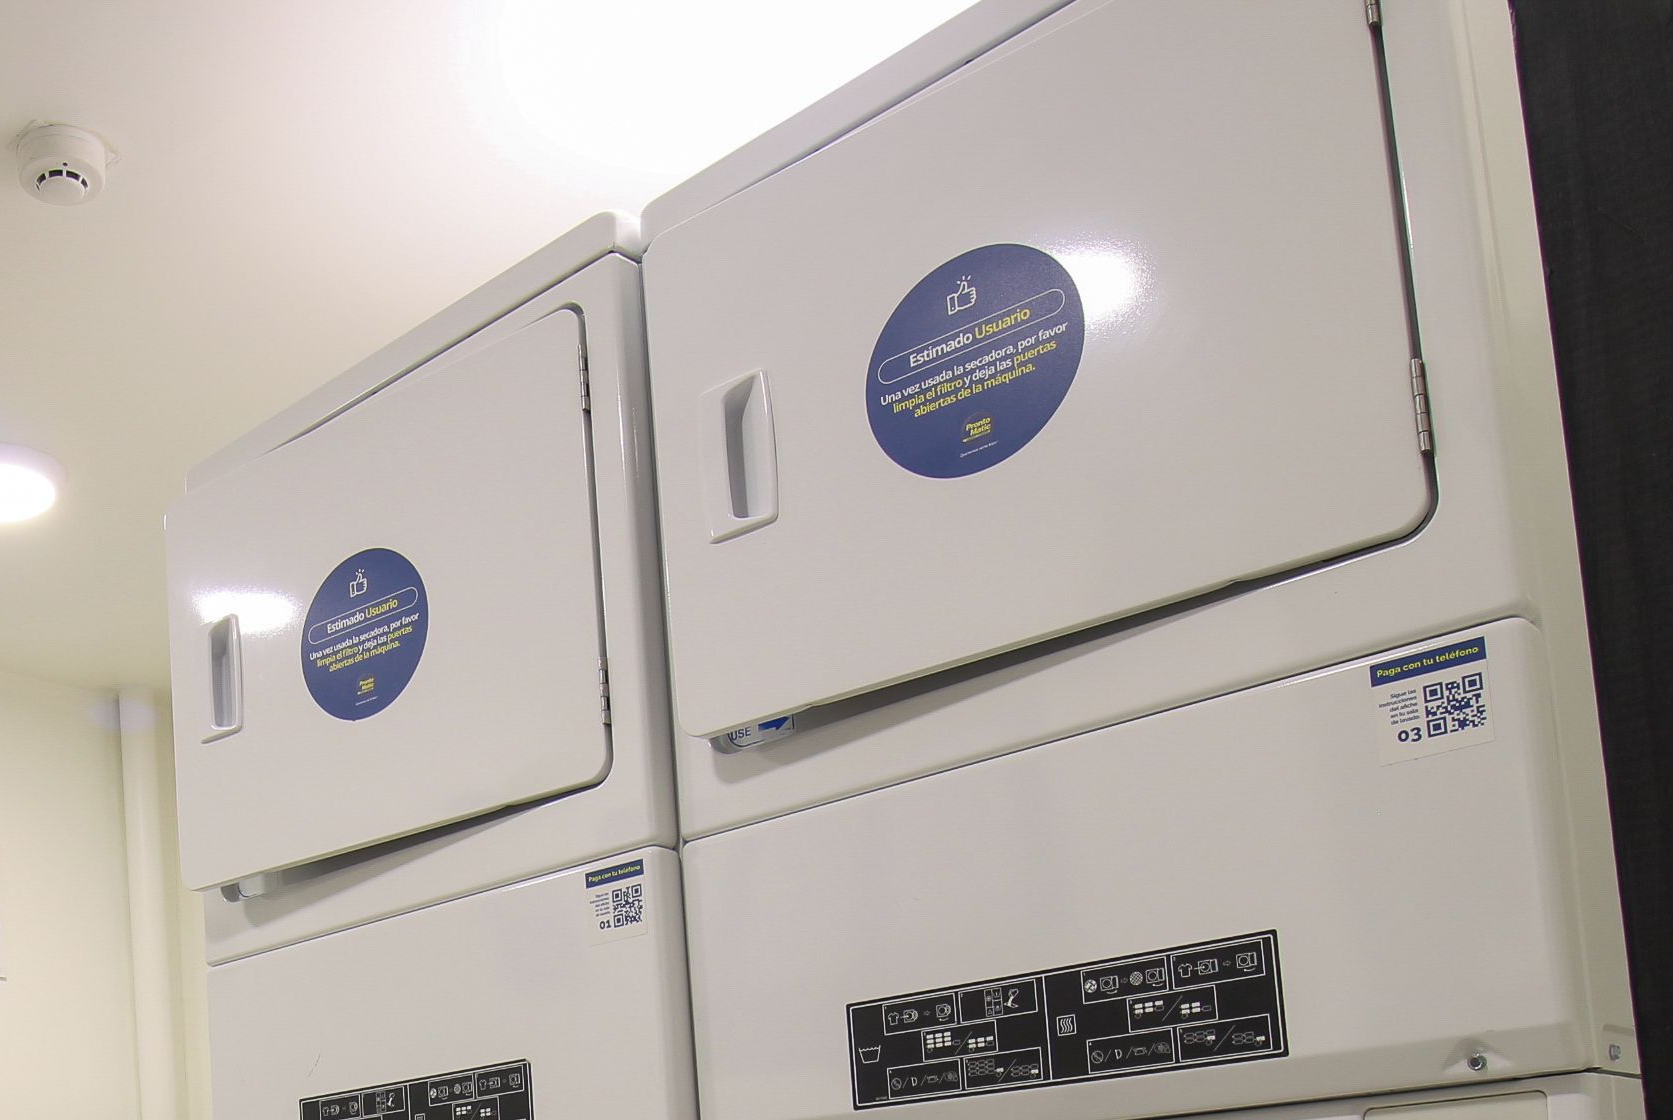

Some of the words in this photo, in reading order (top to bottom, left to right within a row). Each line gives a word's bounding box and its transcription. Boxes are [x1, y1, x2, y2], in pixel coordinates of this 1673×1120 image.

[909, 331, 973, 368] Estimado
[974, 307, 1032, 339] Usuario
[880, 389, 901, 406] Una
[902, 384, 920, 399] vez
[921, 370, 953, 390] usada
[953, 364, 964, 377] la
[965, 344, 1017, 374] secadora,
[1017, 336, 1037, 354] por
[1038, 322, 1068, 343] favor
[893, 394, 925, 414] limpia
[926, 388, 936, 400] el
[936, 377, 963, 397] filtro
[963, 374, 972, 388] y
[972, 365, 995, 386] deja
[996, 358, 1012, 372] las
[1013, 339, 1057, 368] puertas
[914, 394, 957, 418] abiertas
[957, 386, 971, 401] de
[972, 383, 982, 396] la
[984, 363, 1036, 392] máquina.
[966, 416, 991, 431] Pronto
[970, 424, 991, 436] Matic
[327, 610, 365, 634] Estimado
[365, 598, 398, 618] Usuario
[309, 649, 322, 661] Una
[322, 646, 334, 657] vez
[334, 638, 353, 653] usada
[353, 634, 359, 644] la
[359, 624, 389, 642] secadora,
[389, 619, 402, 635] por
[401, 612, 419, 626] favor
[316, 653, 336, 667] limpia
[336, 650, 343, 661] el
[342, 644, 358, 658] filtro
[358, 642, 364, 654] y
[363, 637, 378, 651] deja
[378, 633, 387, 644] las
[387, 625, 413, 643] puertas
[329, 656, 354, 672] abiertas
[354, 652, 363, 663] de
[363, 650, 370, 660] la
[370, 639, 401, 659] máquina.
[1376, 667, 1401, 678] Paga
[1402, 661, 1421, 671] con
[1423, 658, 1434, 667] tu
[1435, 646, 1479, 663] teléfono
[1379, 695, 1417, 709] instrucciones
[1390, 690, 1407, 700] Sigue
[1389, 704, 1400, 713] del
[1400, 701, 1418, 711] afiche
[1407, 707, 1419, 715] sala
[1391, 718, 1399, 726] de
[730, 727, 751, 740] USE
[1397, 726, 1422, 743] 03
[588, 874, 603, 883] Paga
[602, 871, 612, 879] con
[618, 864, 641, 876] teléfono
[599, 920, 612, 930] 01
